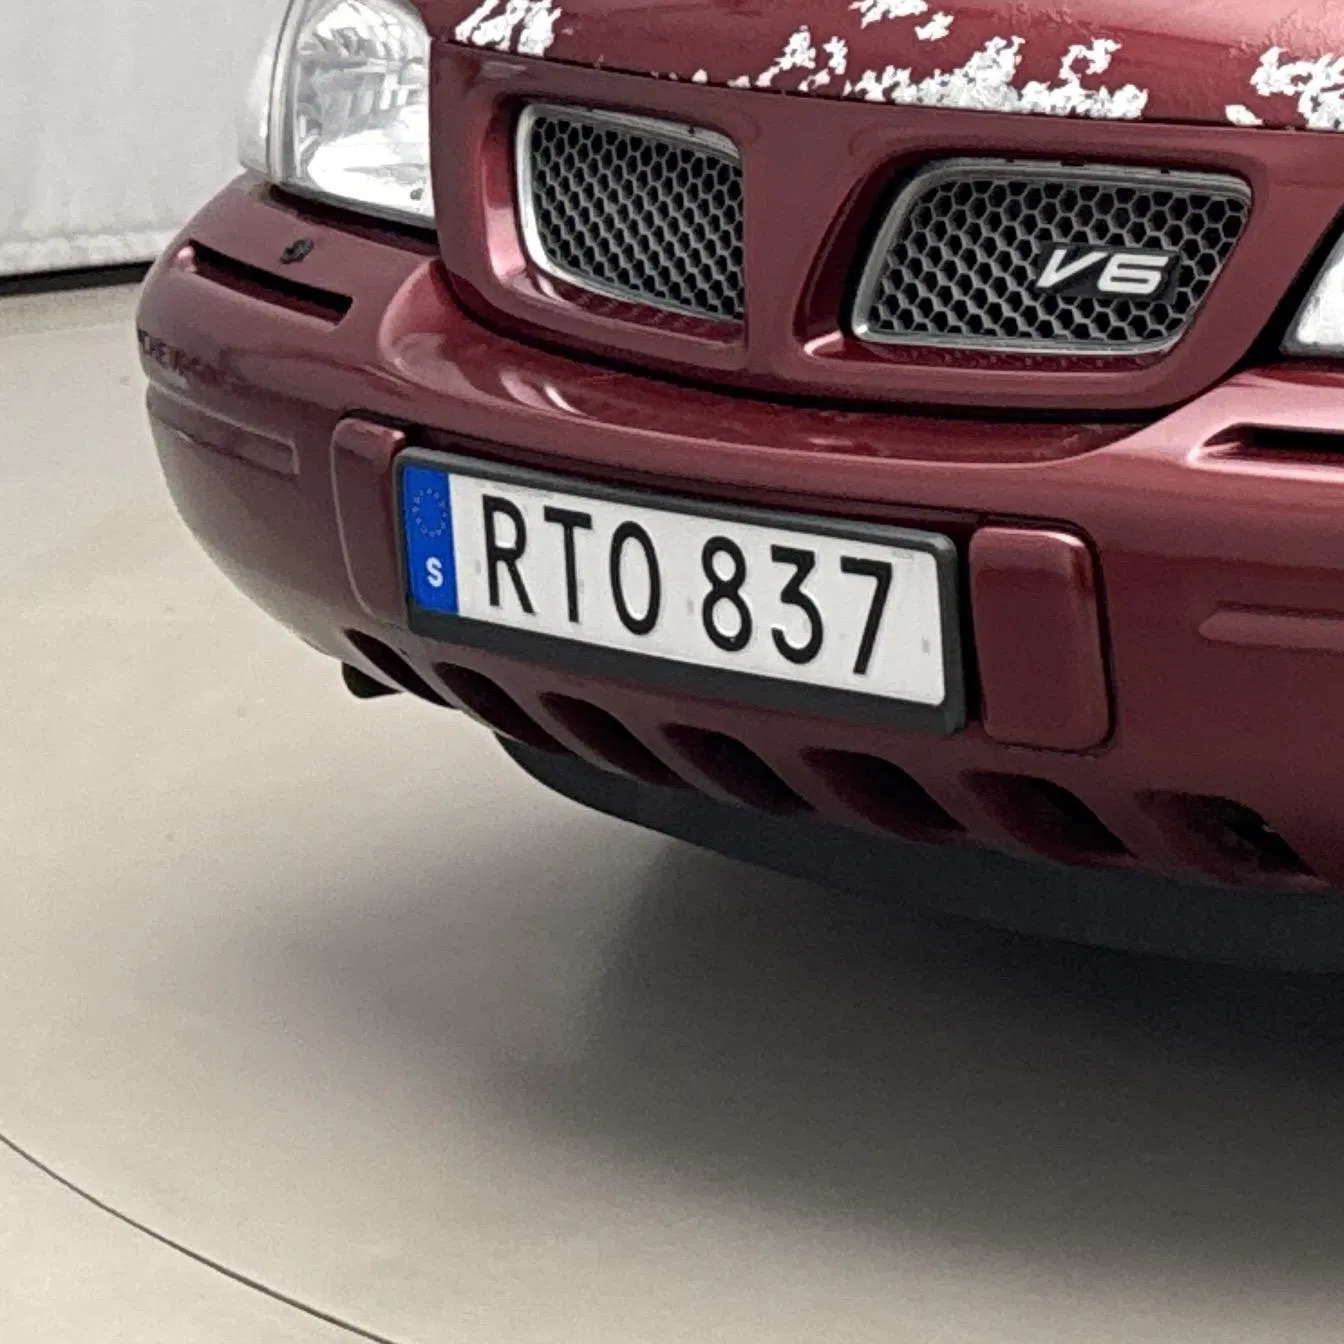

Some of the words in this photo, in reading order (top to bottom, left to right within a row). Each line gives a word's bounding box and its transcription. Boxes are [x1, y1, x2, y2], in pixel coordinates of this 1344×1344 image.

[1036, 248, 1171, 295] V6
[425, 558, 445, 588] S
[481, 494, 661, 635] RTO
[700, 536, 894, 675] 837
